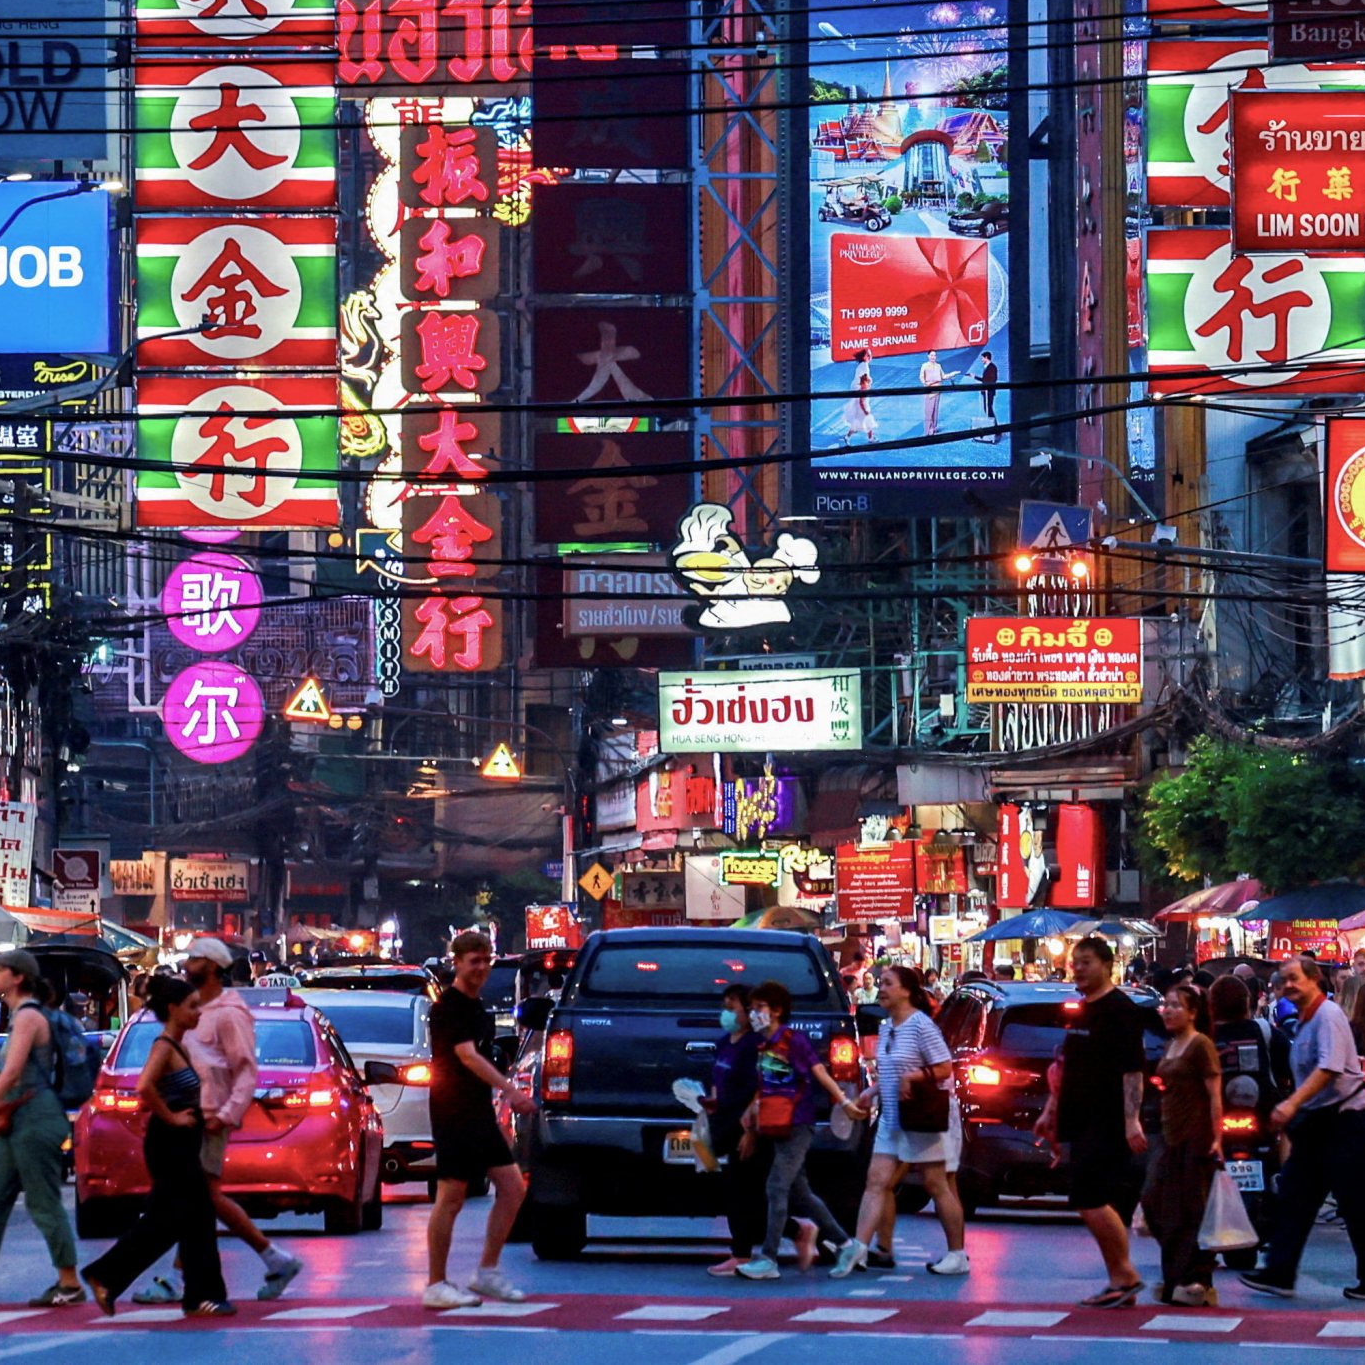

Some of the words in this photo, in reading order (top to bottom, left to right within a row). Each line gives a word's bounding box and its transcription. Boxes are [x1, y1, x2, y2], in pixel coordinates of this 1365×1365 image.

[15, 19, 60, 30] HENG
[1256, 213, 1295, 238] LIM
[1299, 212, 1360, 237] SOON
[840, 308, 855, 319] TH
[858, 307, 883, 318] 9999
[885, 306, 908, 316] 9999
[858, 324, 877, 333] 01/24
[900, 321, 919, 330] 01/29
[840, 338, 869, 349] NAME
[871, 334, 917, 347] SURNAME
[818, 470, 1006, 482] WWW.THAILANDPRIVILEGE.CO.TH
[672, 733, 692, 744] HUA
[694, 733, 721, 744] SENG
[580, 1018, 612, 1027] TOYOTA
